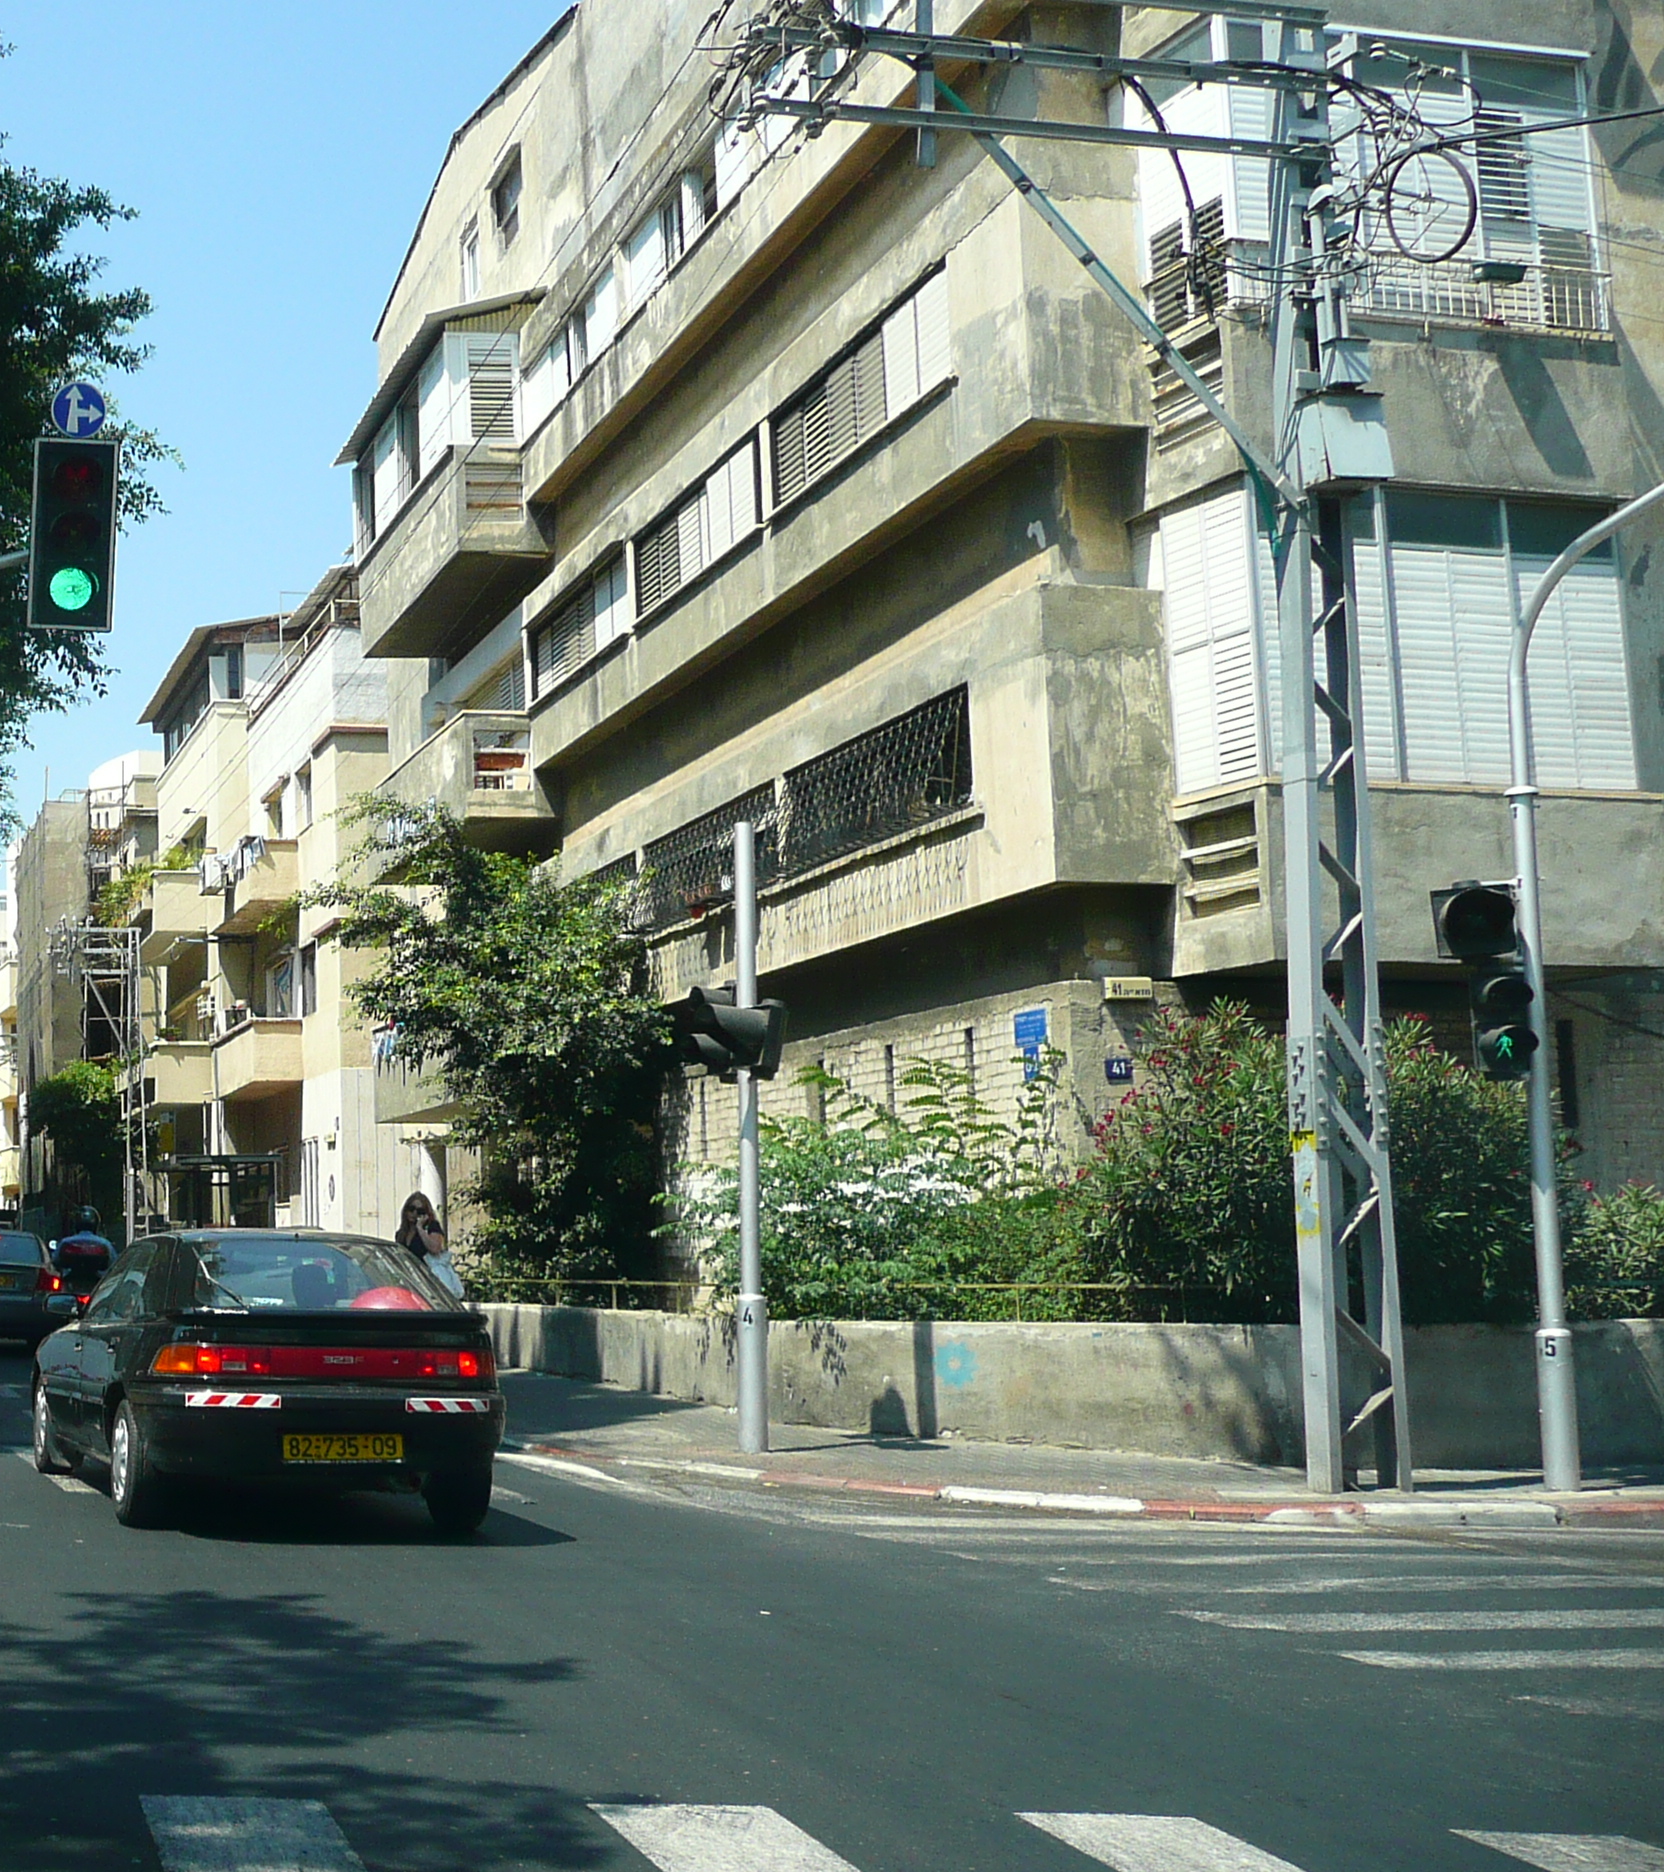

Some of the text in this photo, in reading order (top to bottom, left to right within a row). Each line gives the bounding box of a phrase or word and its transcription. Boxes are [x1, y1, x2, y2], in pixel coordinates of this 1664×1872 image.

[1111, 1061, 1126, 1075] 41
[742, 1306, 754, 1325] 4
[1545, 1336, 1557, 1357] 5
